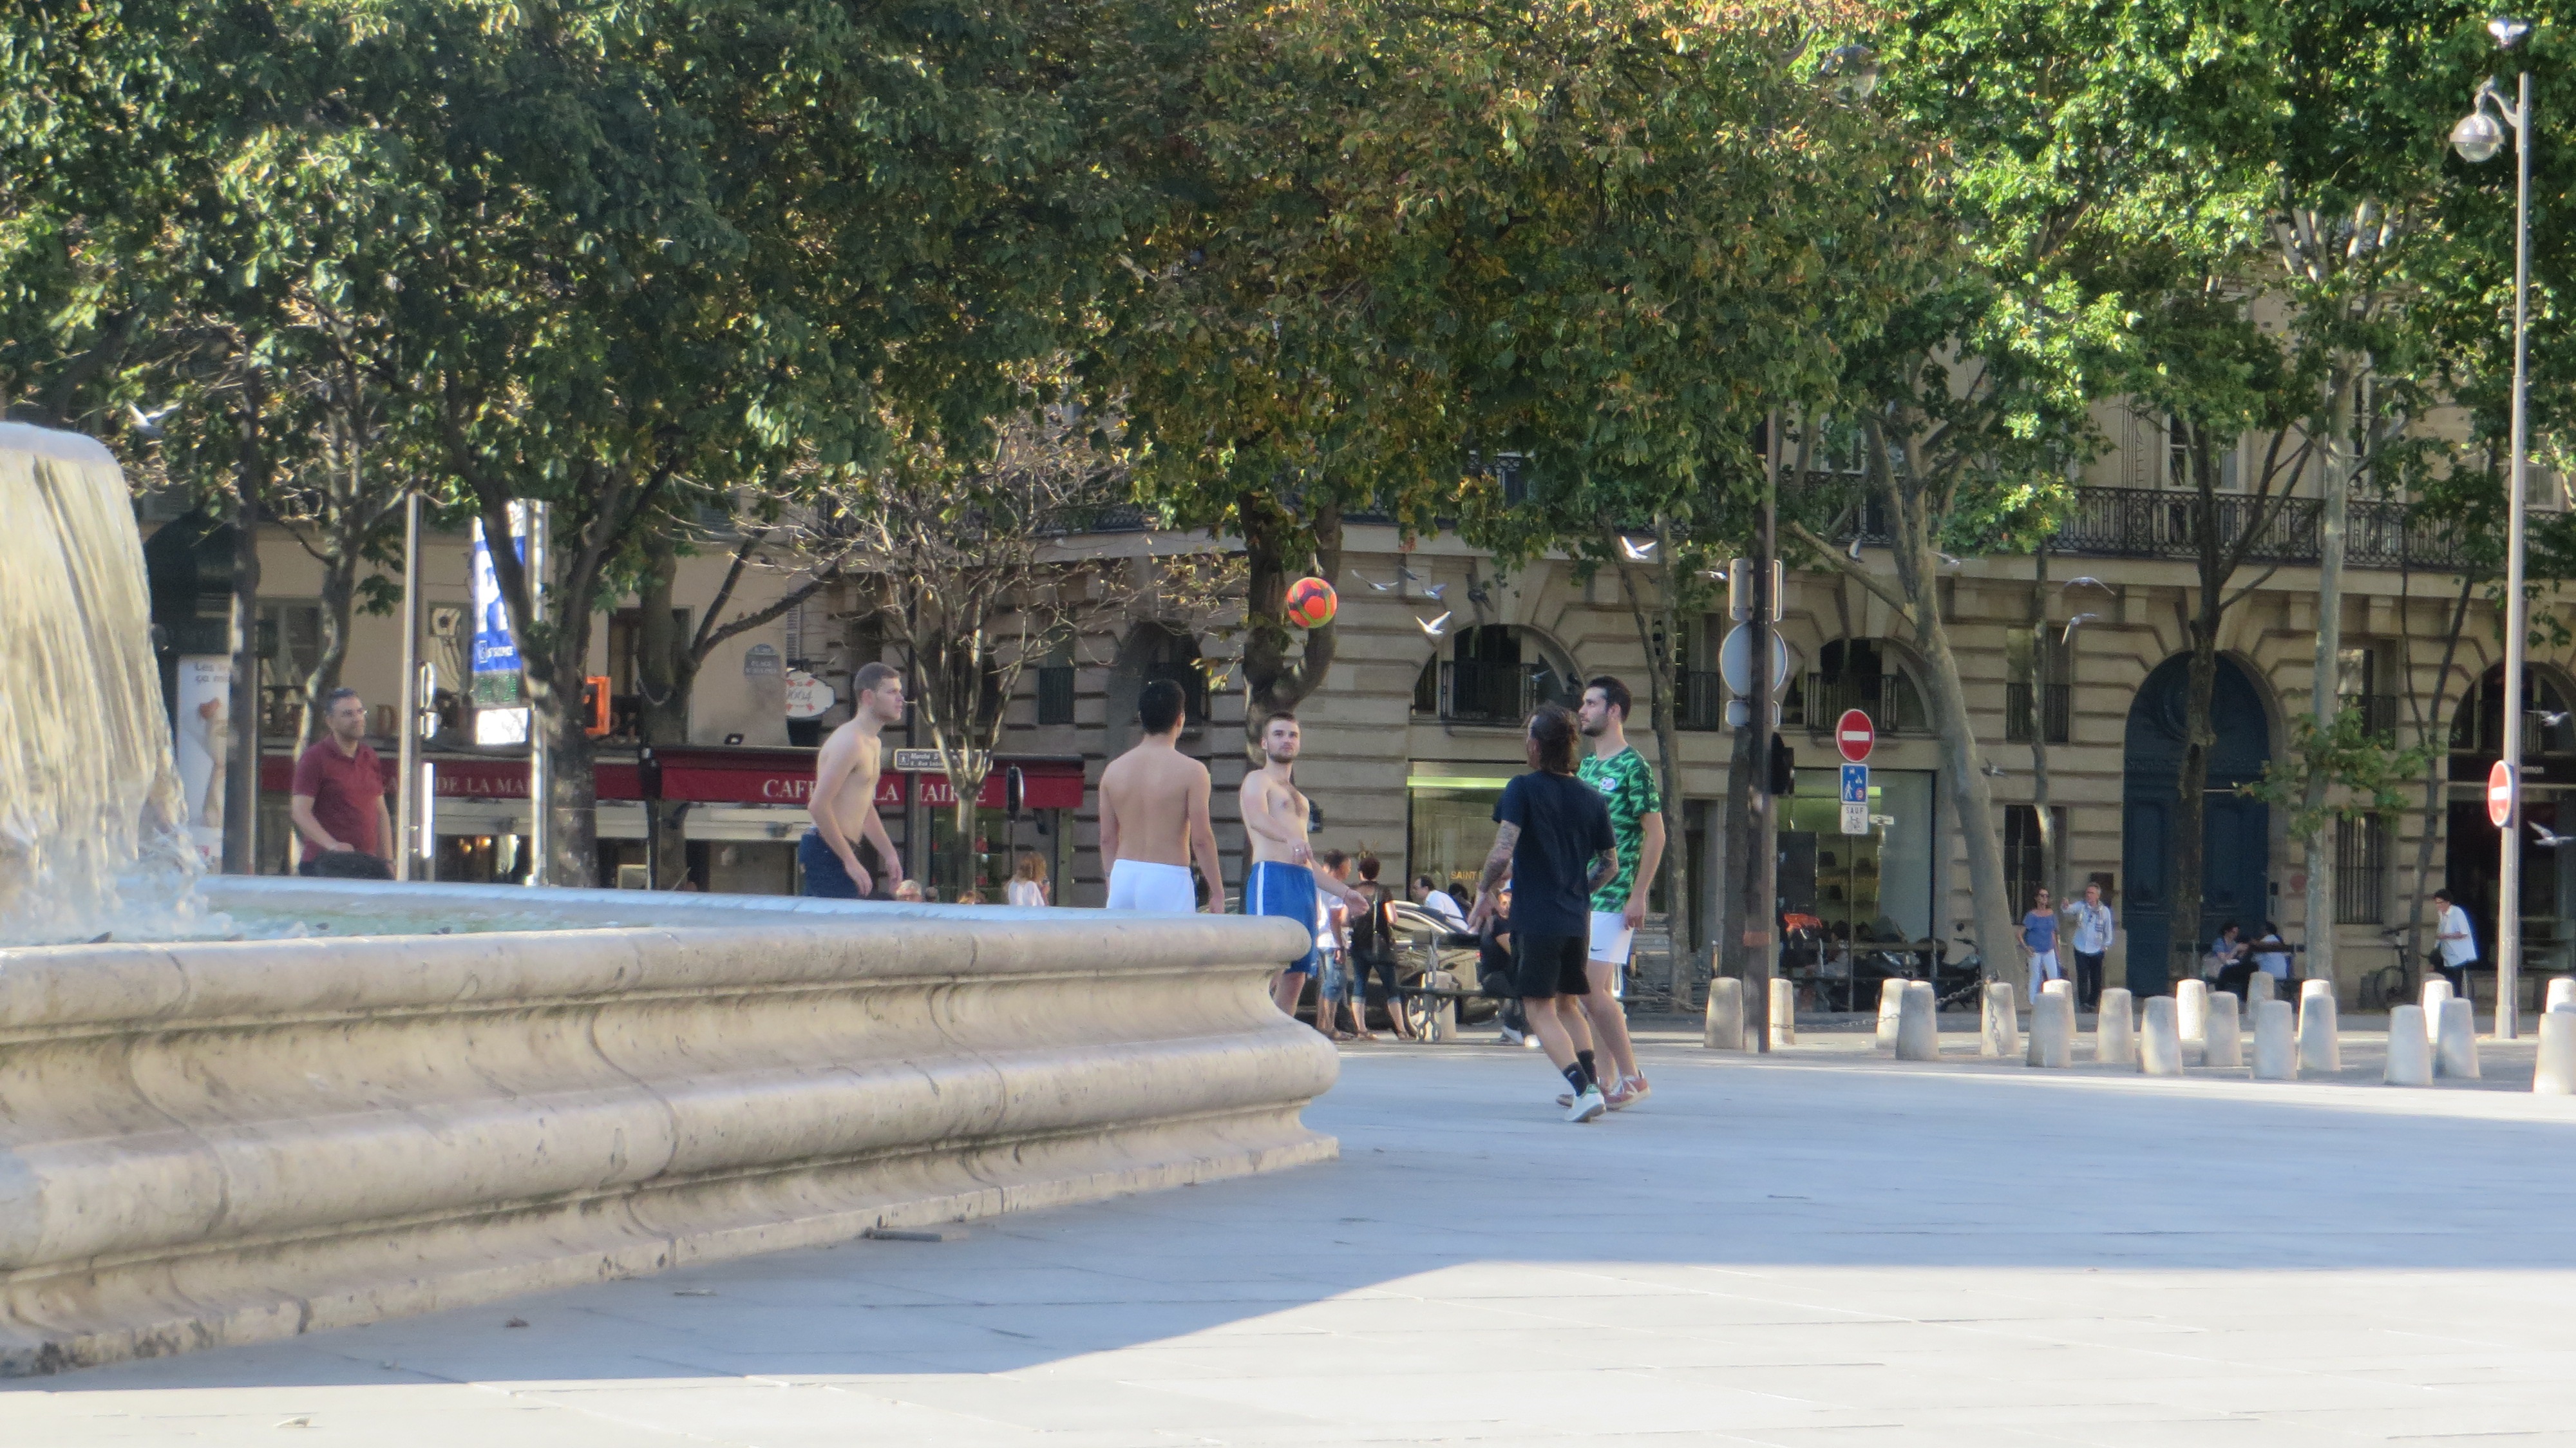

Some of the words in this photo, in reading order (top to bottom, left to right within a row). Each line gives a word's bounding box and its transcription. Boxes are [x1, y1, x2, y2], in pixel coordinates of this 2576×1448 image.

[435, 777, 460, 792] DE
[467, 777, 491, 794] LA
[496, 777, 532, 794] MAI
[1450, 870, 1477, 880] SAINT
